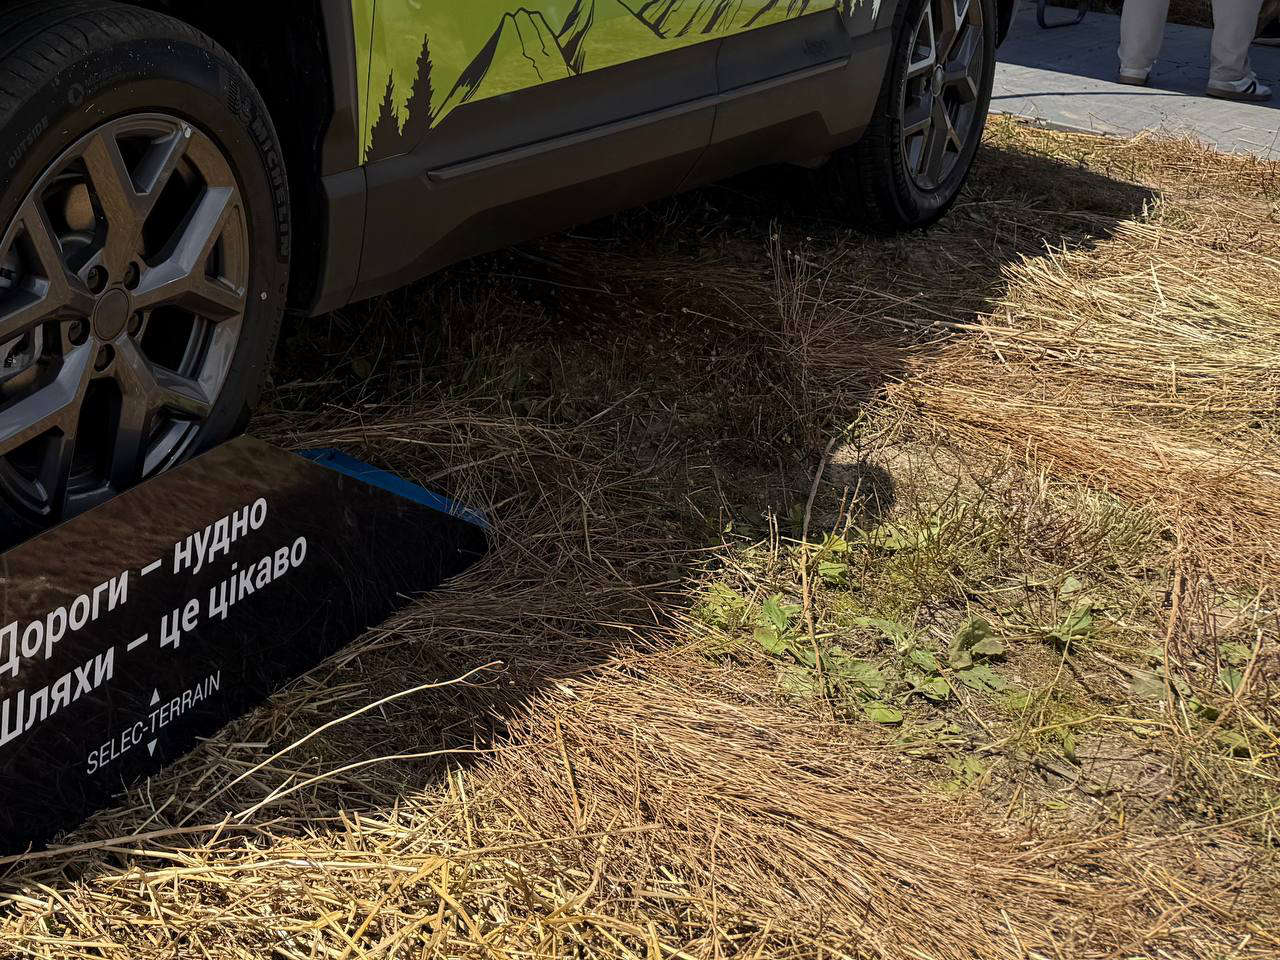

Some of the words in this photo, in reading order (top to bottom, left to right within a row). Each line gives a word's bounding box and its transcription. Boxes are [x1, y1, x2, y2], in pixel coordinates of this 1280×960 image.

[173, 496, 268, 574] нудно
[159, 597, 200, 649] це
[207, 535, 308, 621] цікаво
